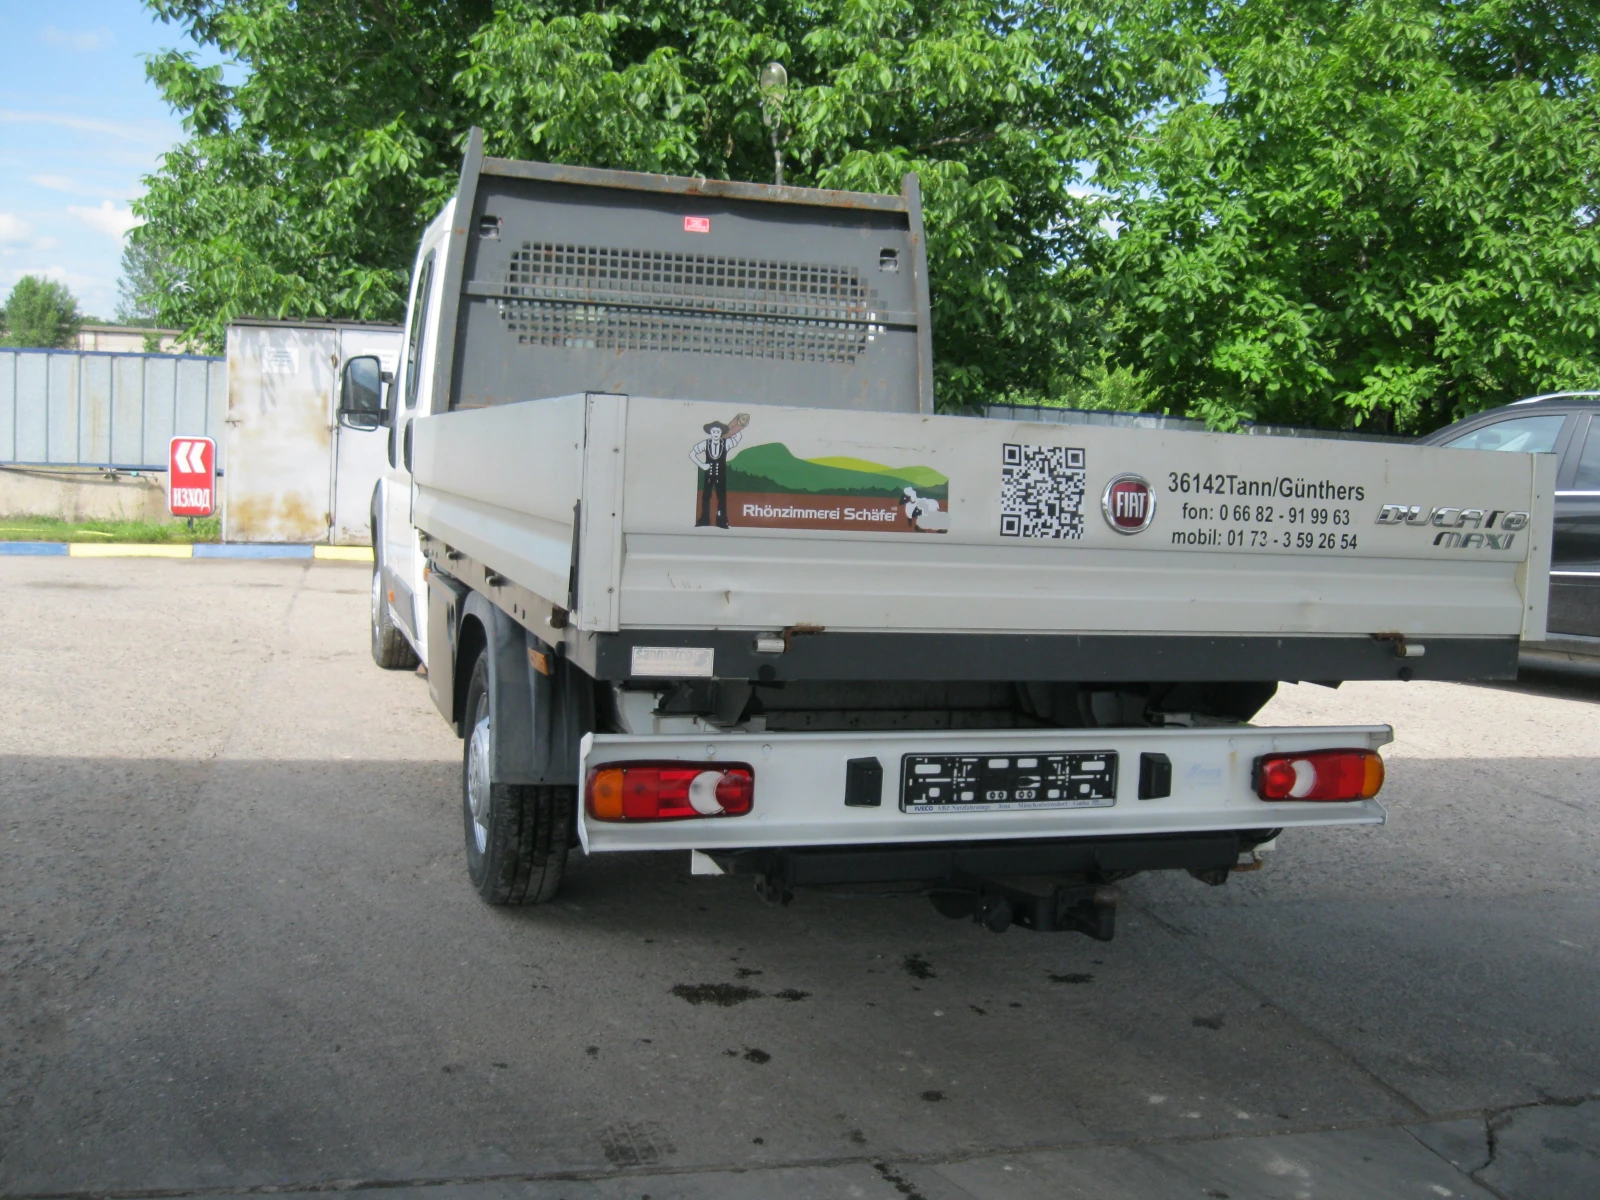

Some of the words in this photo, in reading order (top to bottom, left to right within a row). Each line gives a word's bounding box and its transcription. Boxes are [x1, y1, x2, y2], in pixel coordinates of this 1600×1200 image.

[173, 487, 211, 512] ИЗХОД
[1116, 491, 1147, 518] FIAT
[743, 504, 840, 520] Rhönzimmerei
[844, 507, 897, 522] Schäfer
[1182, 502, 1214, 520] fon:
[1255, 506, 1274, 523] 82
[1288, 507, 1305, 524] 91
[1310, 508, 1328, 525] 99
[1333, 509, 1350, 526] 63
[1375, 503, 1530, 532] DUCATO
[1171, 528, 1222, 546] mobil:
[1227, 530, 1244, 547] 01
[1250, 530, 1268, 547] 73
[1296, 532, 1314, 549] 59
[1318, 533, 1336, 550] 26
[1340, 534, 1358, 550] 54
[1432, 531, 1516, 550] MAXI
